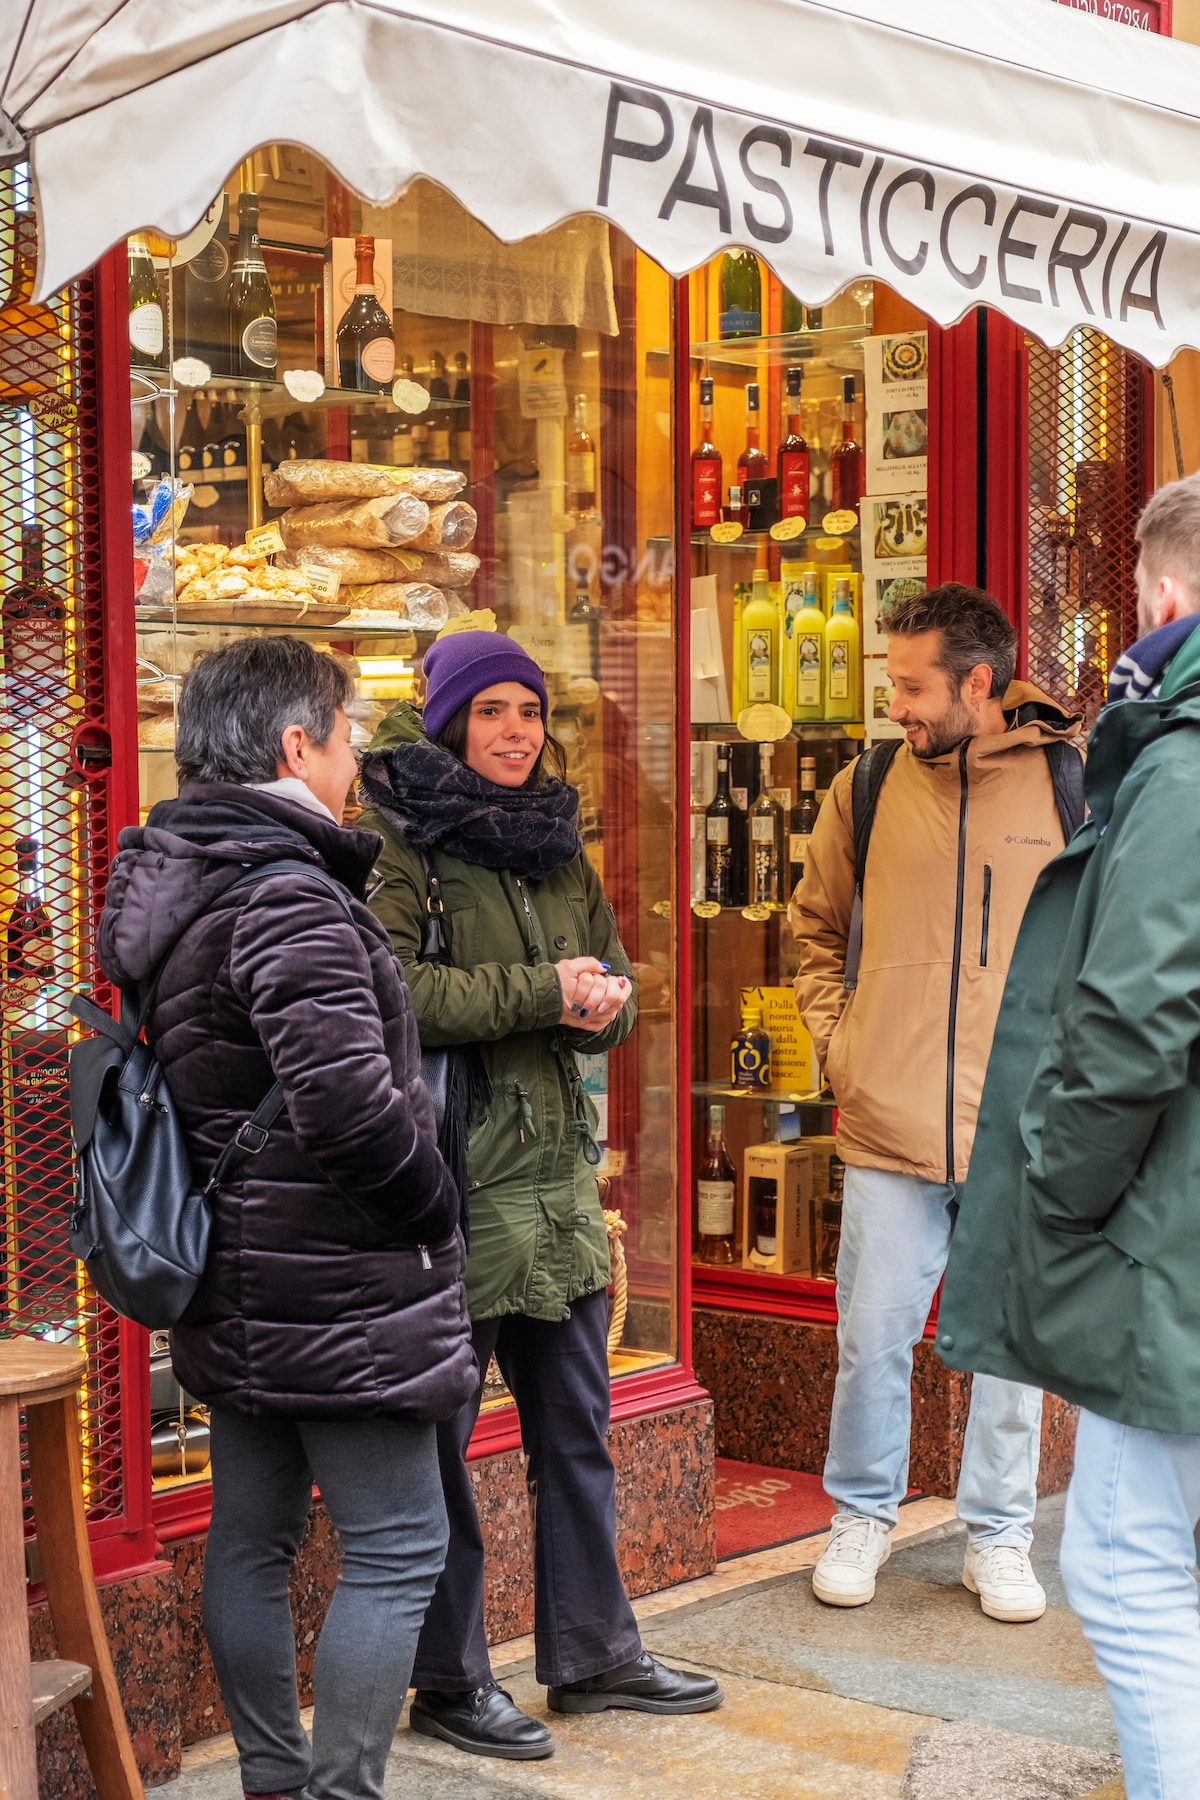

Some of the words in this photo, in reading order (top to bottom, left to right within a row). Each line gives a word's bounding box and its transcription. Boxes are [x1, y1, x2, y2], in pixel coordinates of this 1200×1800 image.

[596, 80, 1167, 331] PASTICCERIA
[1013, 835, 1051, 847] Columbia
[769, 999, 794, 1009] Dalla
[776, 1034, 798, 1044] dalla
